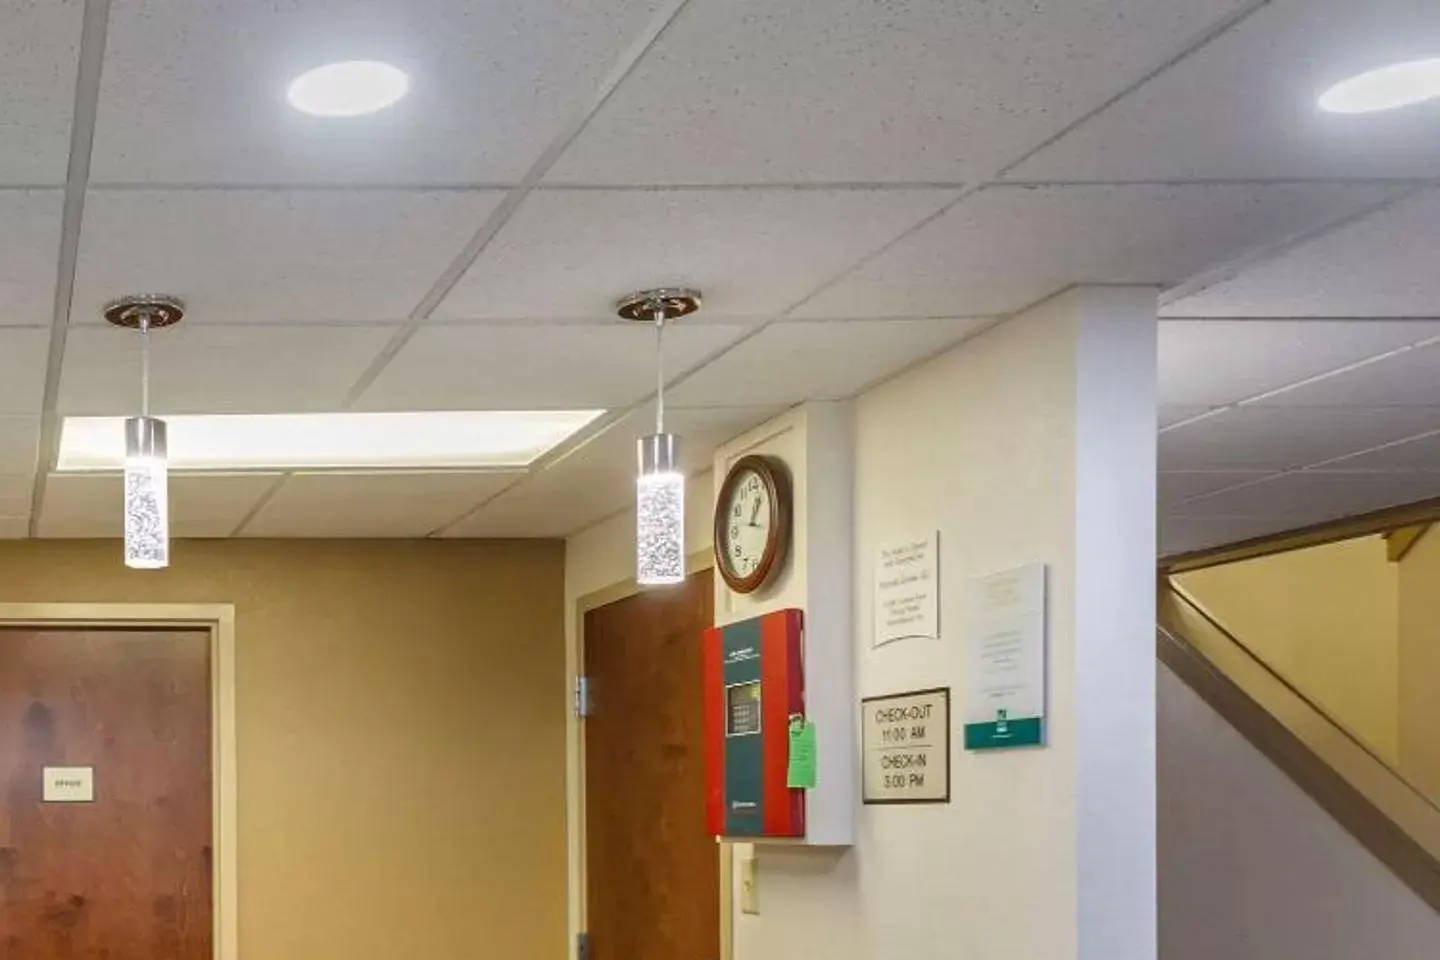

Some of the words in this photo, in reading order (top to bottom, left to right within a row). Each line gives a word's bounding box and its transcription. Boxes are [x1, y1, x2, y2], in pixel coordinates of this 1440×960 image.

[875, 704, 933, 723] CHECK-OUT
[910, 726, 926, 739] AM
[881, 754, 927, 769] CHECK-IN
[910, 773, 925, 788] PM
